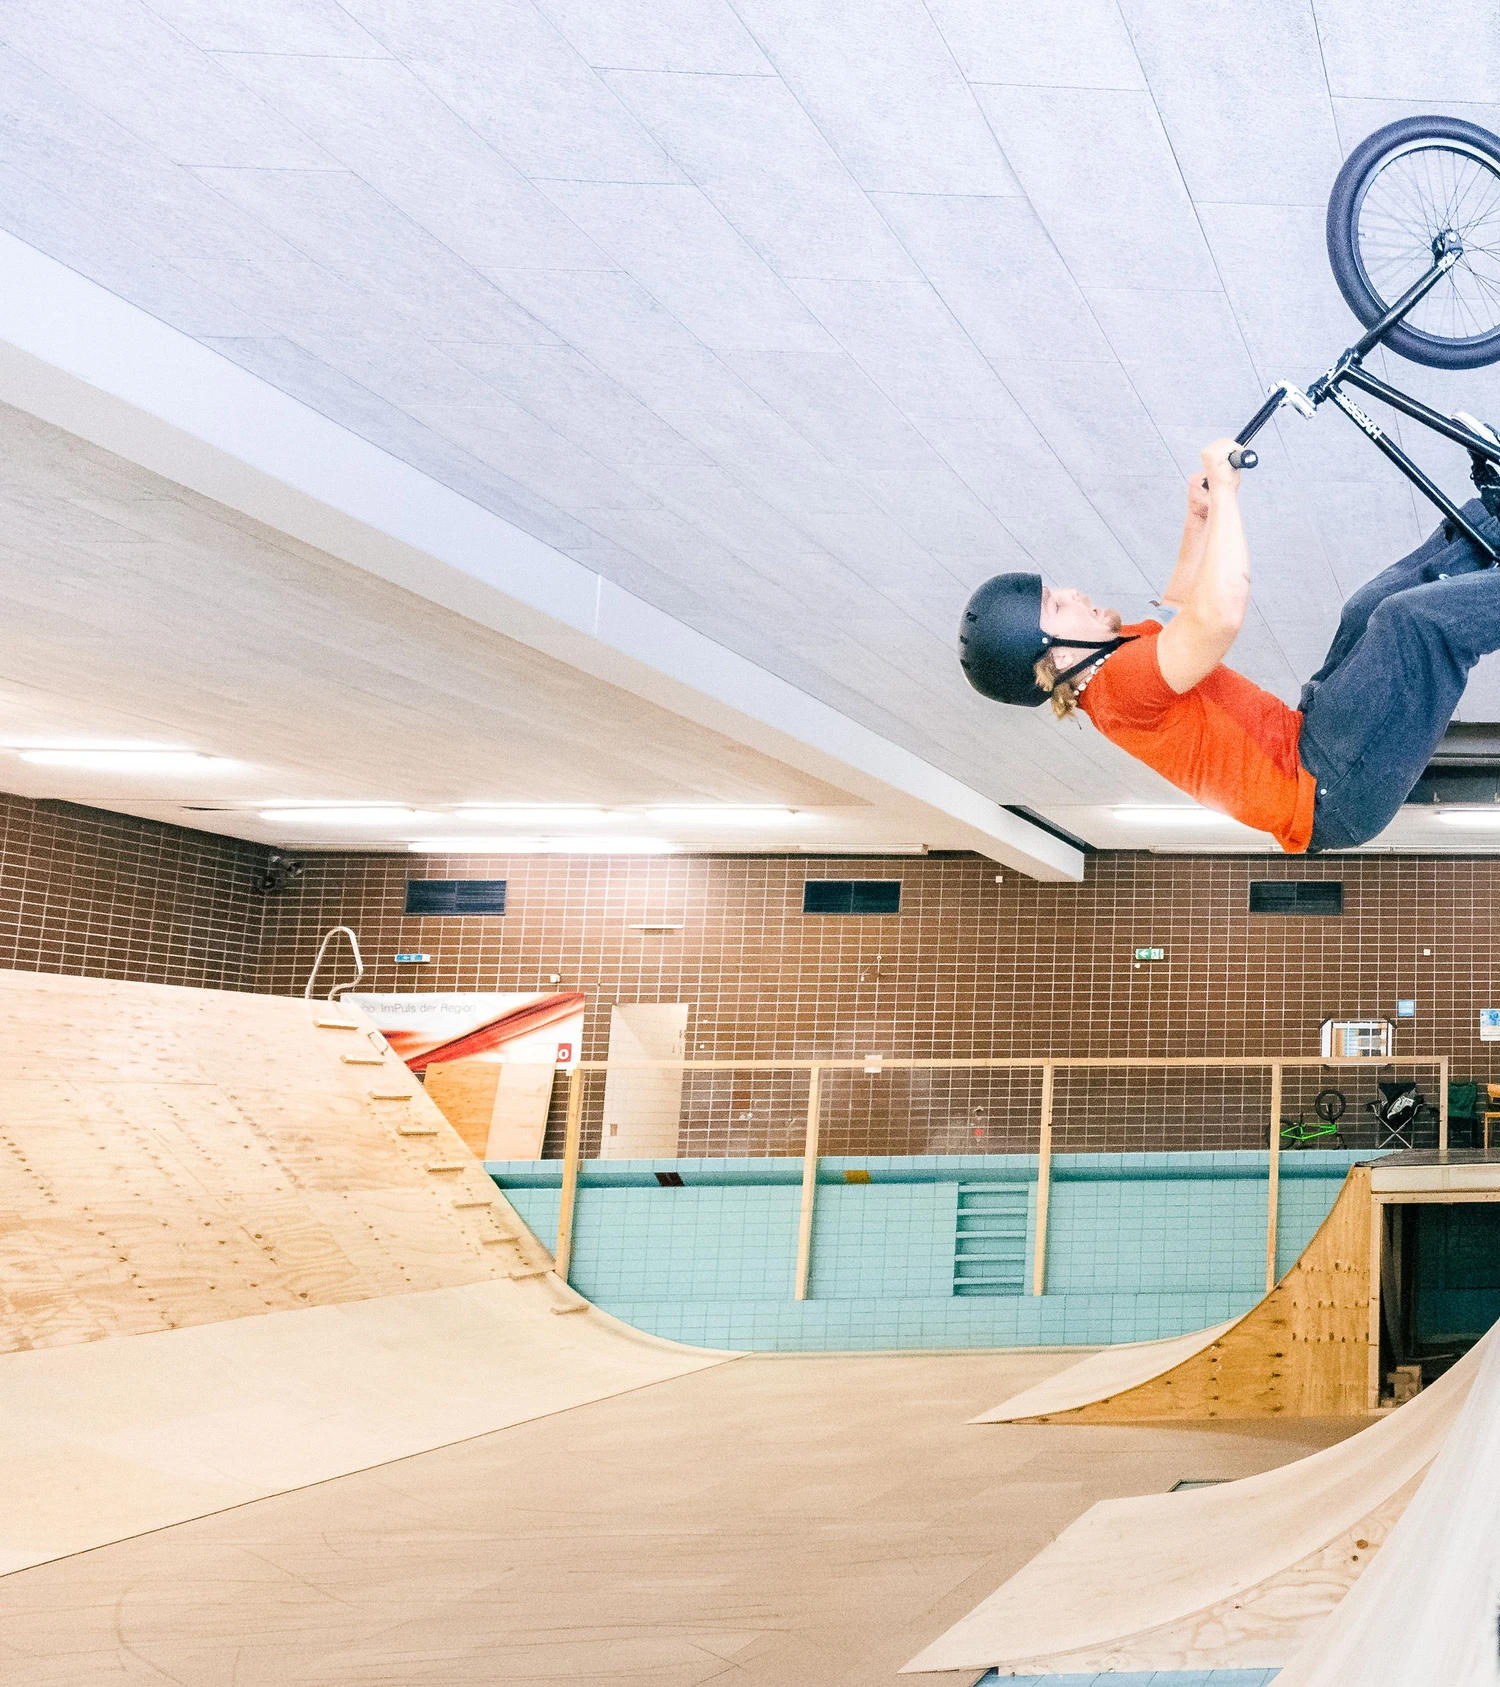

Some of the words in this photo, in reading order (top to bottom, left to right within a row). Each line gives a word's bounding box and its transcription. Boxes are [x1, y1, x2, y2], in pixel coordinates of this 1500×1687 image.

[381, 1003, 416, 1014] ImPuls
[420, 1003, 436, 1013] der
[440, 1003, 477, 1014] Region
